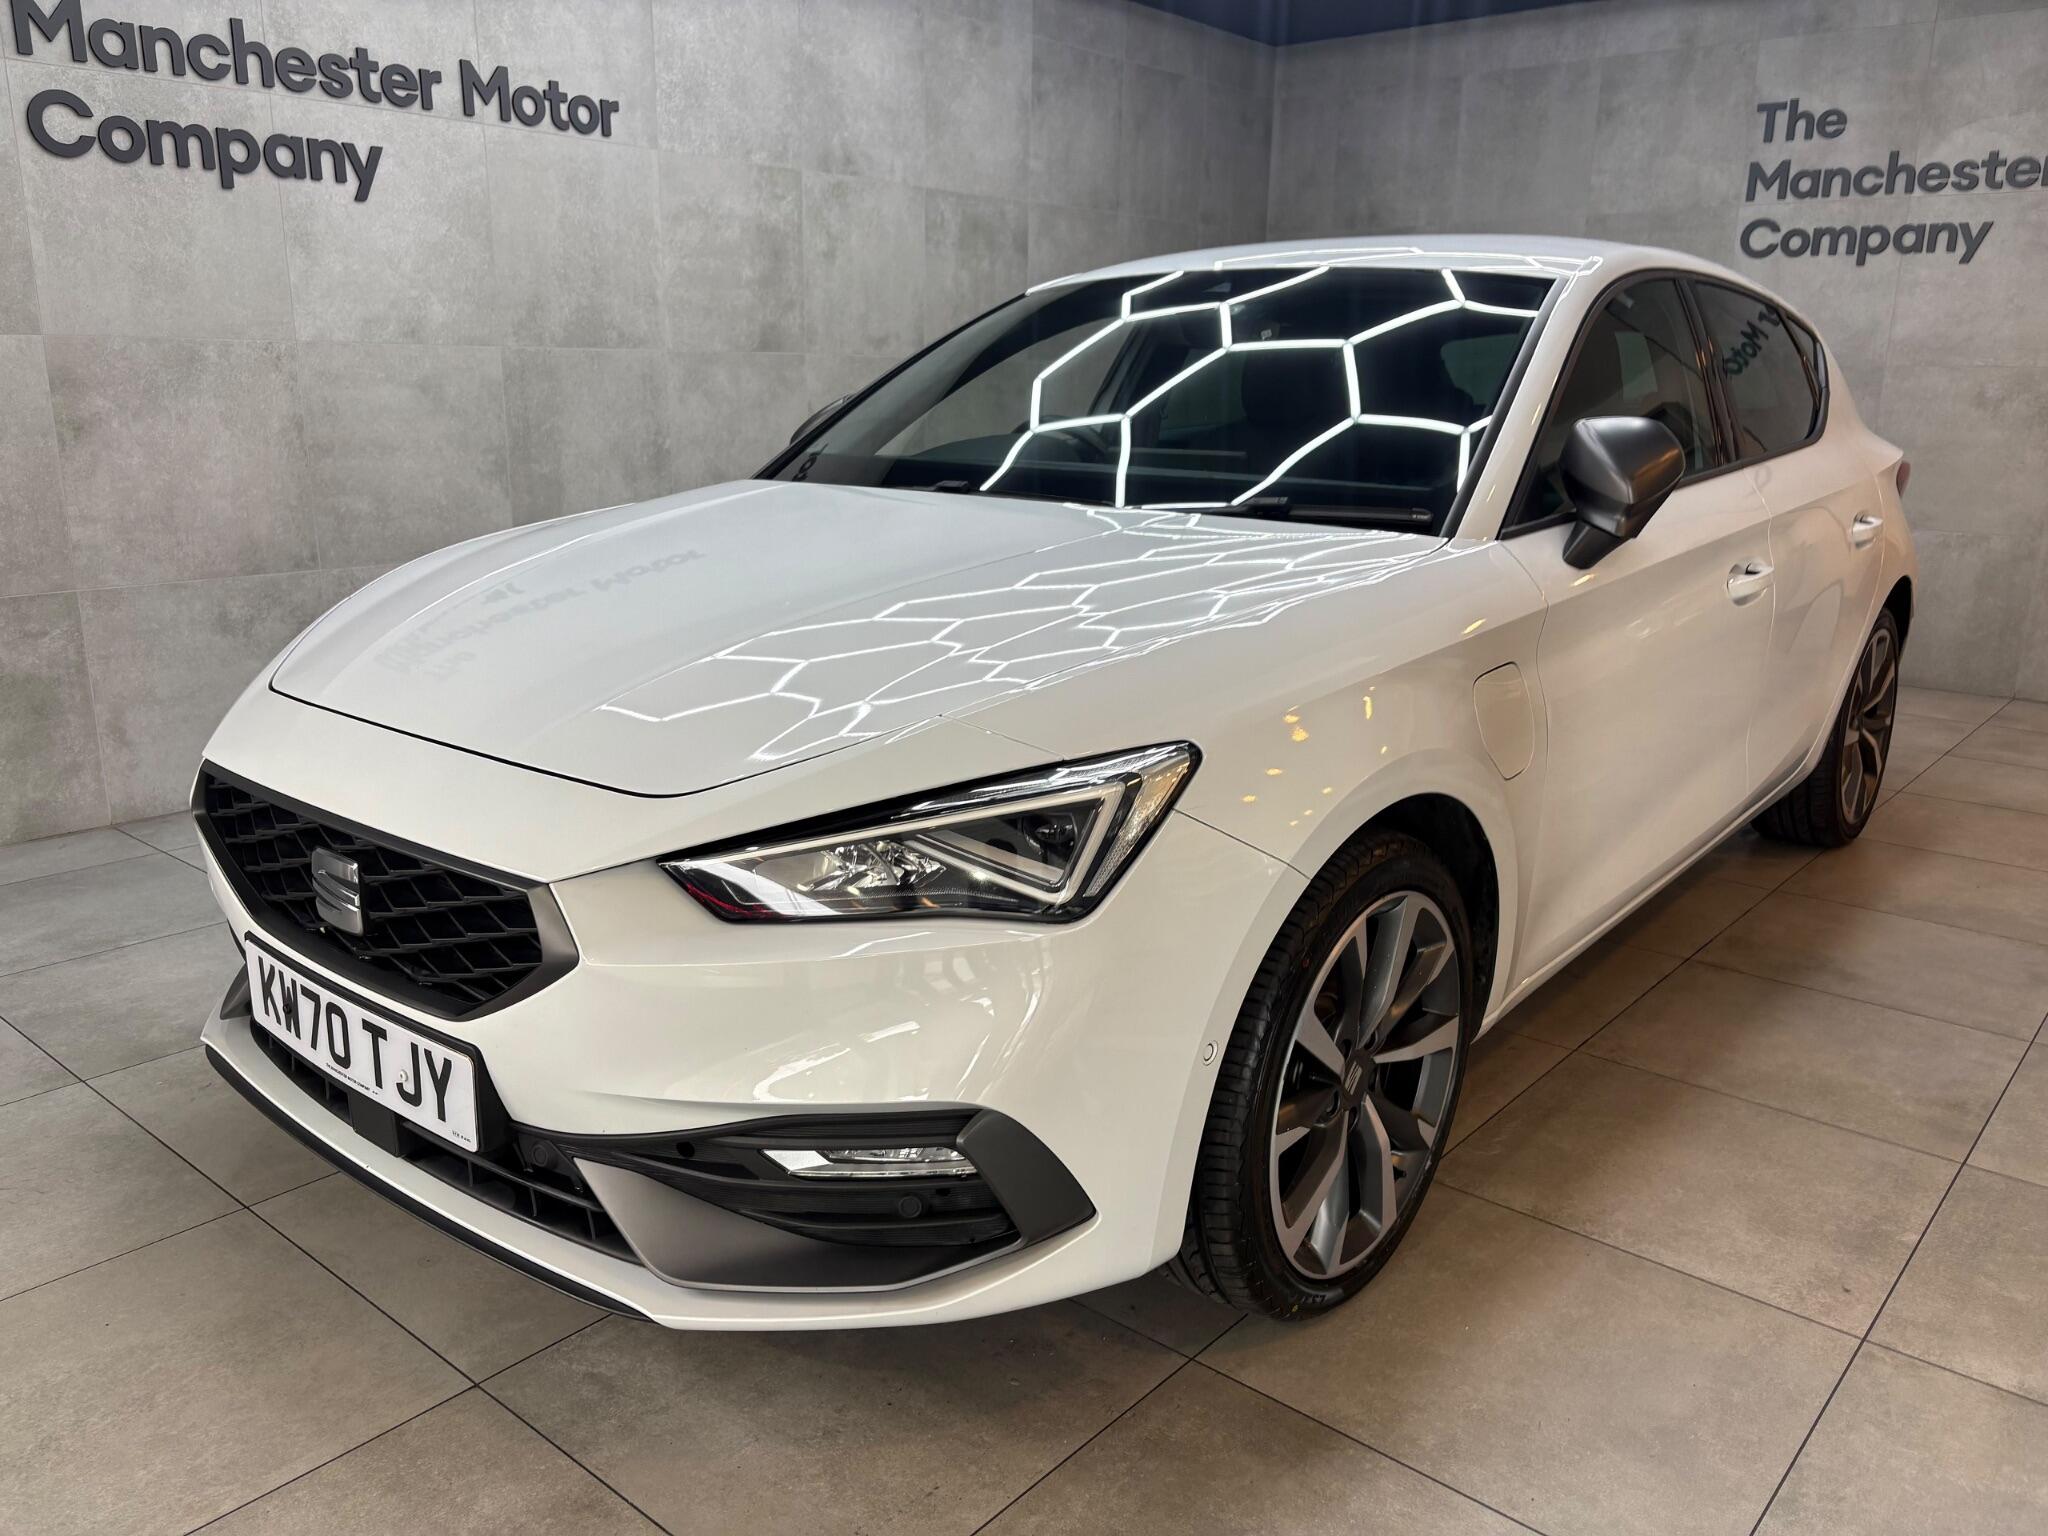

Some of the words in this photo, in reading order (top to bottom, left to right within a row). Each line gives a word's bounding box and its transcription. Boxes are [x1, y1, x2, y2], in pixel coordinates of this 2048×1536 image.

[11, 0, 442, 110] Manchester
[459, 59, 620, 138] Motor
[1757, 97, 1848, 143] The
[27, 89, 383, 202] Company
[1740, 218, 1994, 266] Company
[258, 956, 351, 1070] KW70
